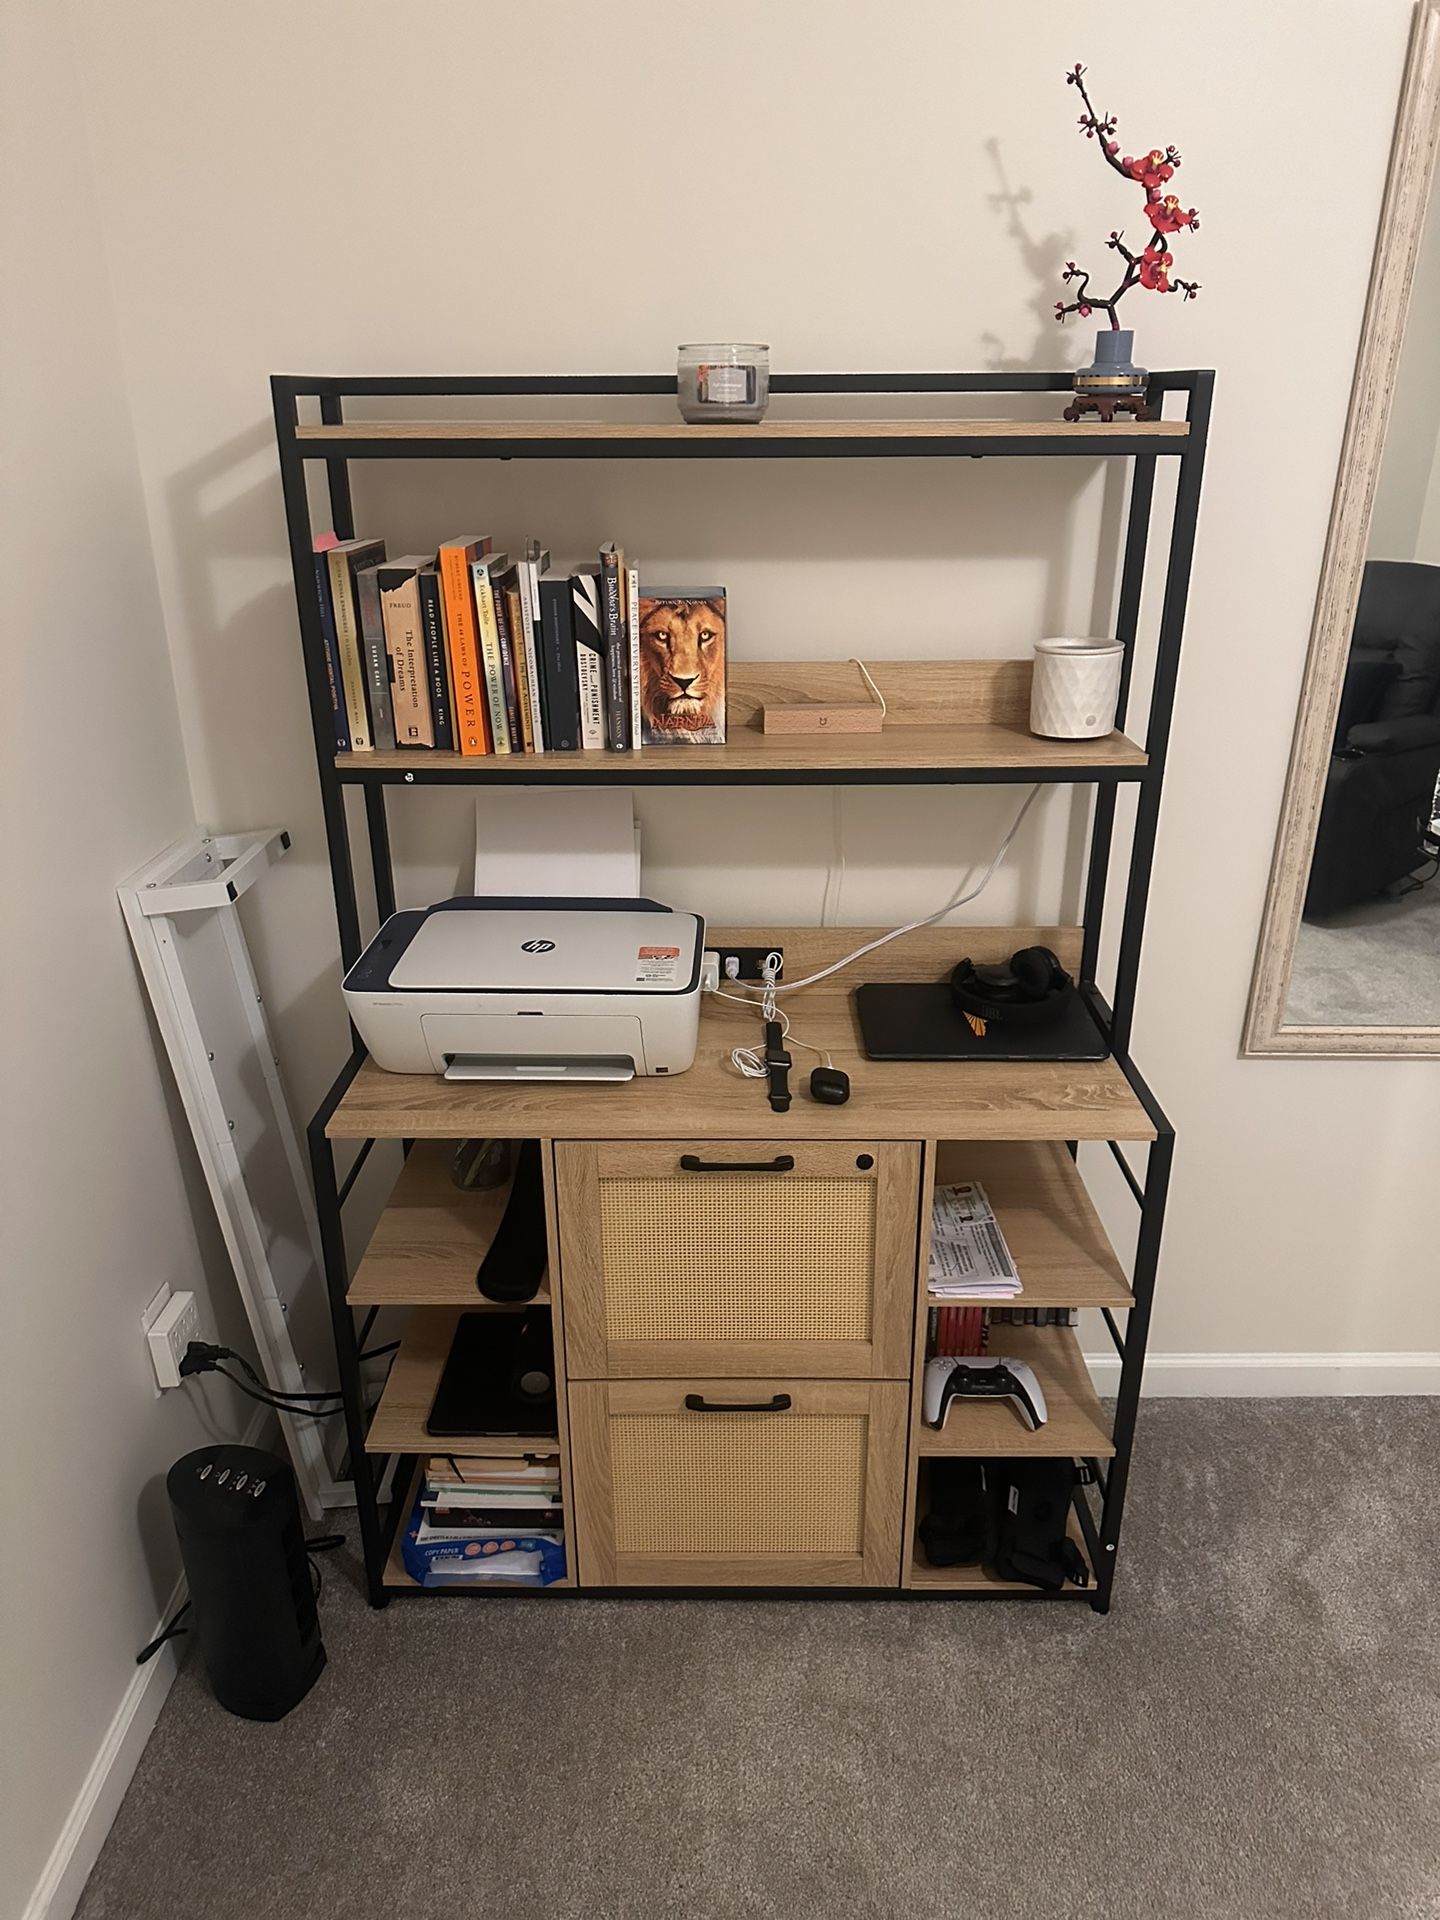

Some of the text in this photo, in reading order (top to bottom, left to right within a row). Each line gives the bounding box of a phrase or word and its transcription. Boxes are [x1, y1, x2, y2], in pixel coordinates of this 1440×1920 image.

[390, 601, 411, 610] FREUD
[427, 599, 435, 618] READ
[479, 584, 490, 625] Eckhart Tolle
[523, 596, 531, 634] ARISTOTLE
[429, 621, 438, 649] PEOPLE
[608, 613, 619, 636] Brain
[632, 633, 638, 641] IS
[371, 645, 379, 667] SUSAN
[462, 658, 467, 667] OF
[588, 653, 598, 673] CRIME
[395, 646, 407, 692] of Dreams
[405, 630, 420, 709] The Interpretation
[527, 647, 537, 697] NICOMACHEAN
[579, 654, 590, 691] DOSTOEVSKY
[434, 677, 442, 698] BOOK
[461, 671, 476, 728] POWER
[486, 642, 503, 732] THE POWER OF NOW
[589, 684, 602, 725] PUNISHMENT
[652, 713, 716, 731] NARNIA
[524, 938, 553, 954] hp
